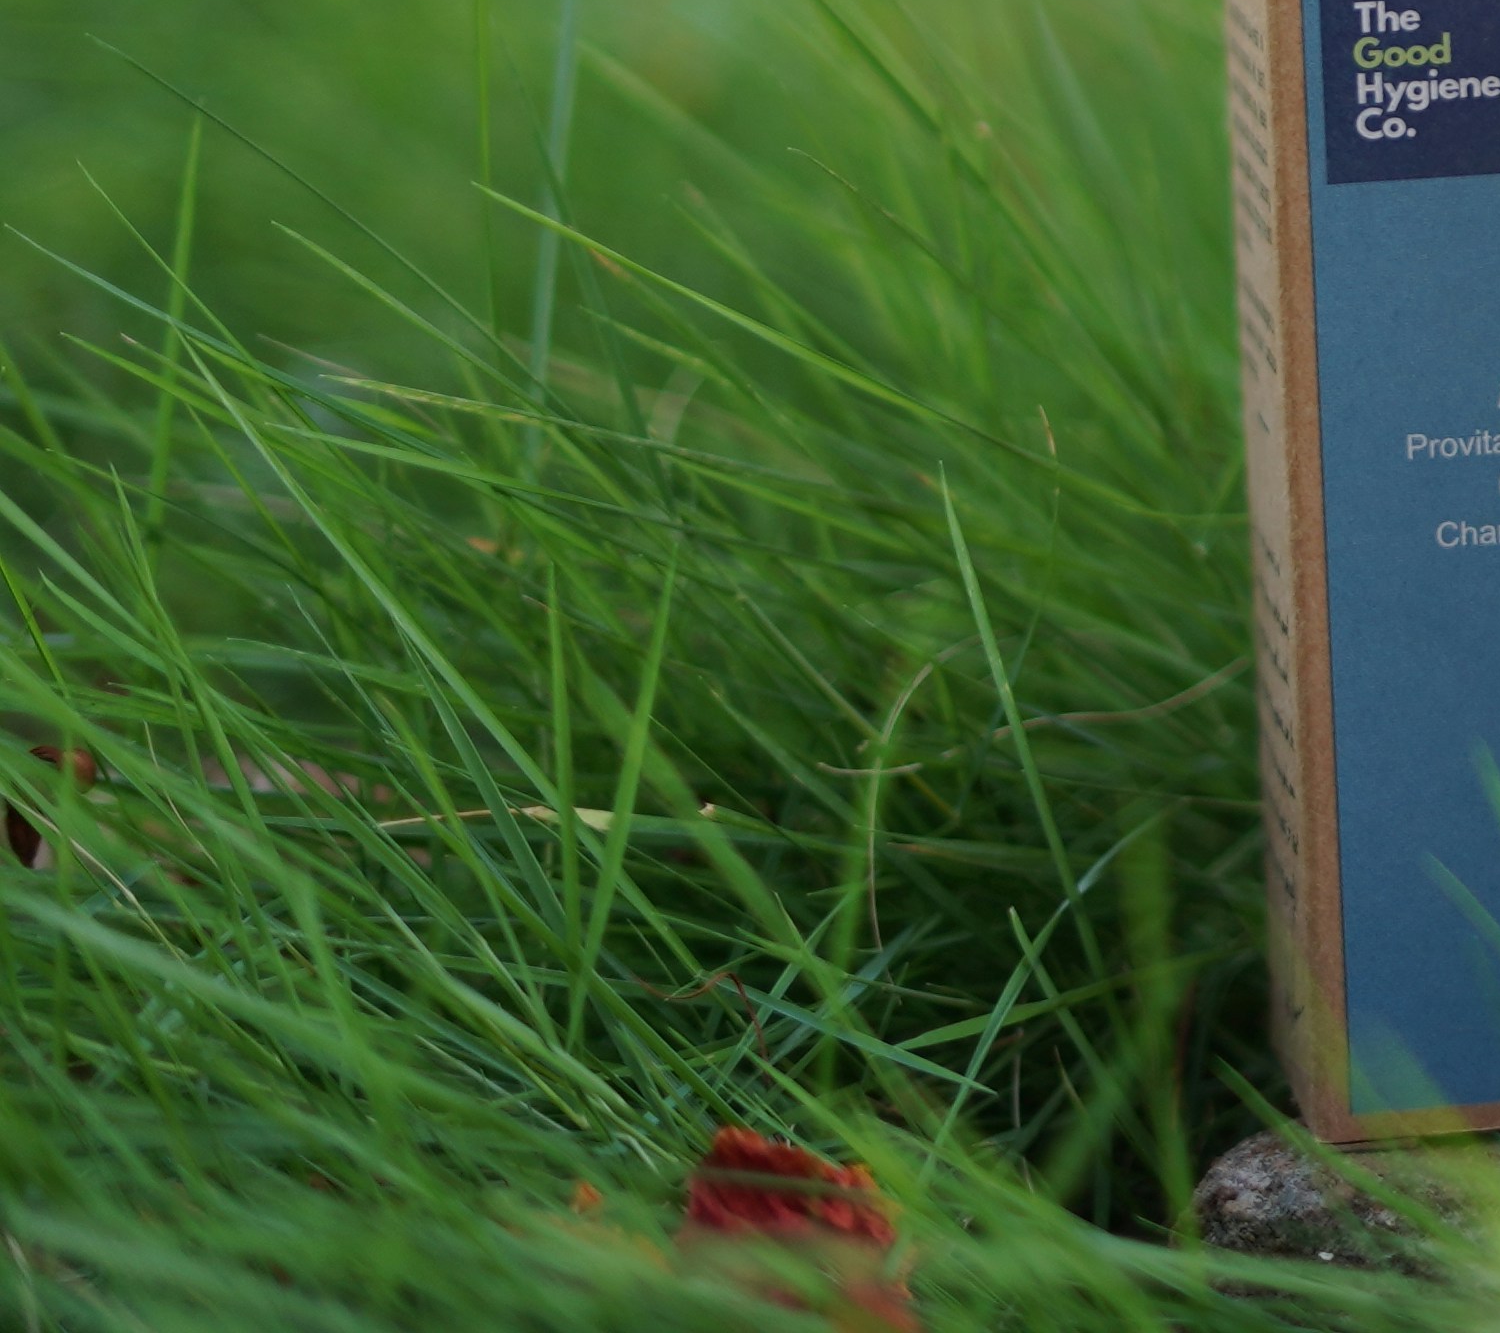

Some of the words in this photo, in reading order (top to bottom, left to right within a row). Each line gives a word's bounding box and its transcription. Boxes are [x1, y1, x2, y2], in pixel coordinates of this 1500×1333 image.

[1353, 0, 1421, 34] The
[1352, 32, 1452, 70] Good
[1355, 107, 1417, 140] Co.
